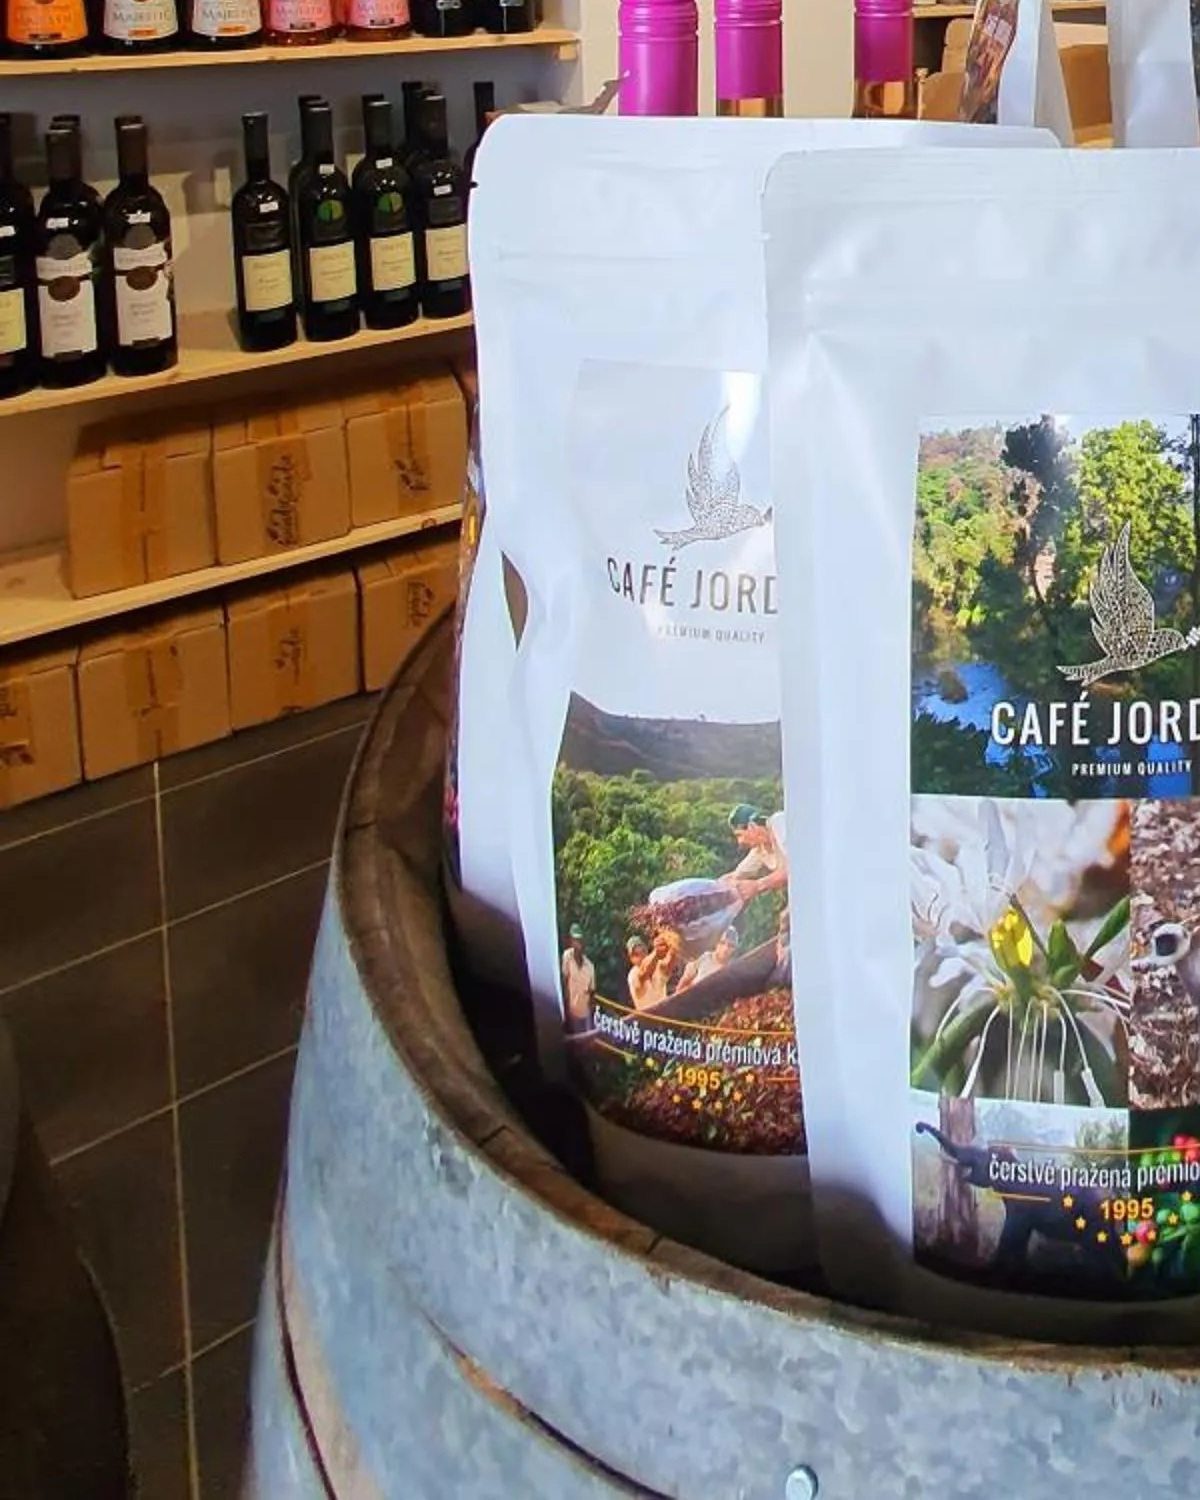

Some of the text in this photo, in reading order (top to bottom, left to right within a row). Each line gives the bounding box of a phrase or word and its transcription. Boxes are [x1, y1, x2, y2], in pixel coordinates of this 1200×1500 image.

[607, 556, 778, 615] CAFÉ JORD
[991, 691, 1091, 746] CAFÉ
[1072, 759, 1192, 777] PREMIUM QUALITY
[643, 1030, 701, 1060] pražená
[675, 1066, 721, 1089] 1995
[1060, 1160, 1131, 1190] pražená
[1101, 1198, 1154, 1221] 1995
